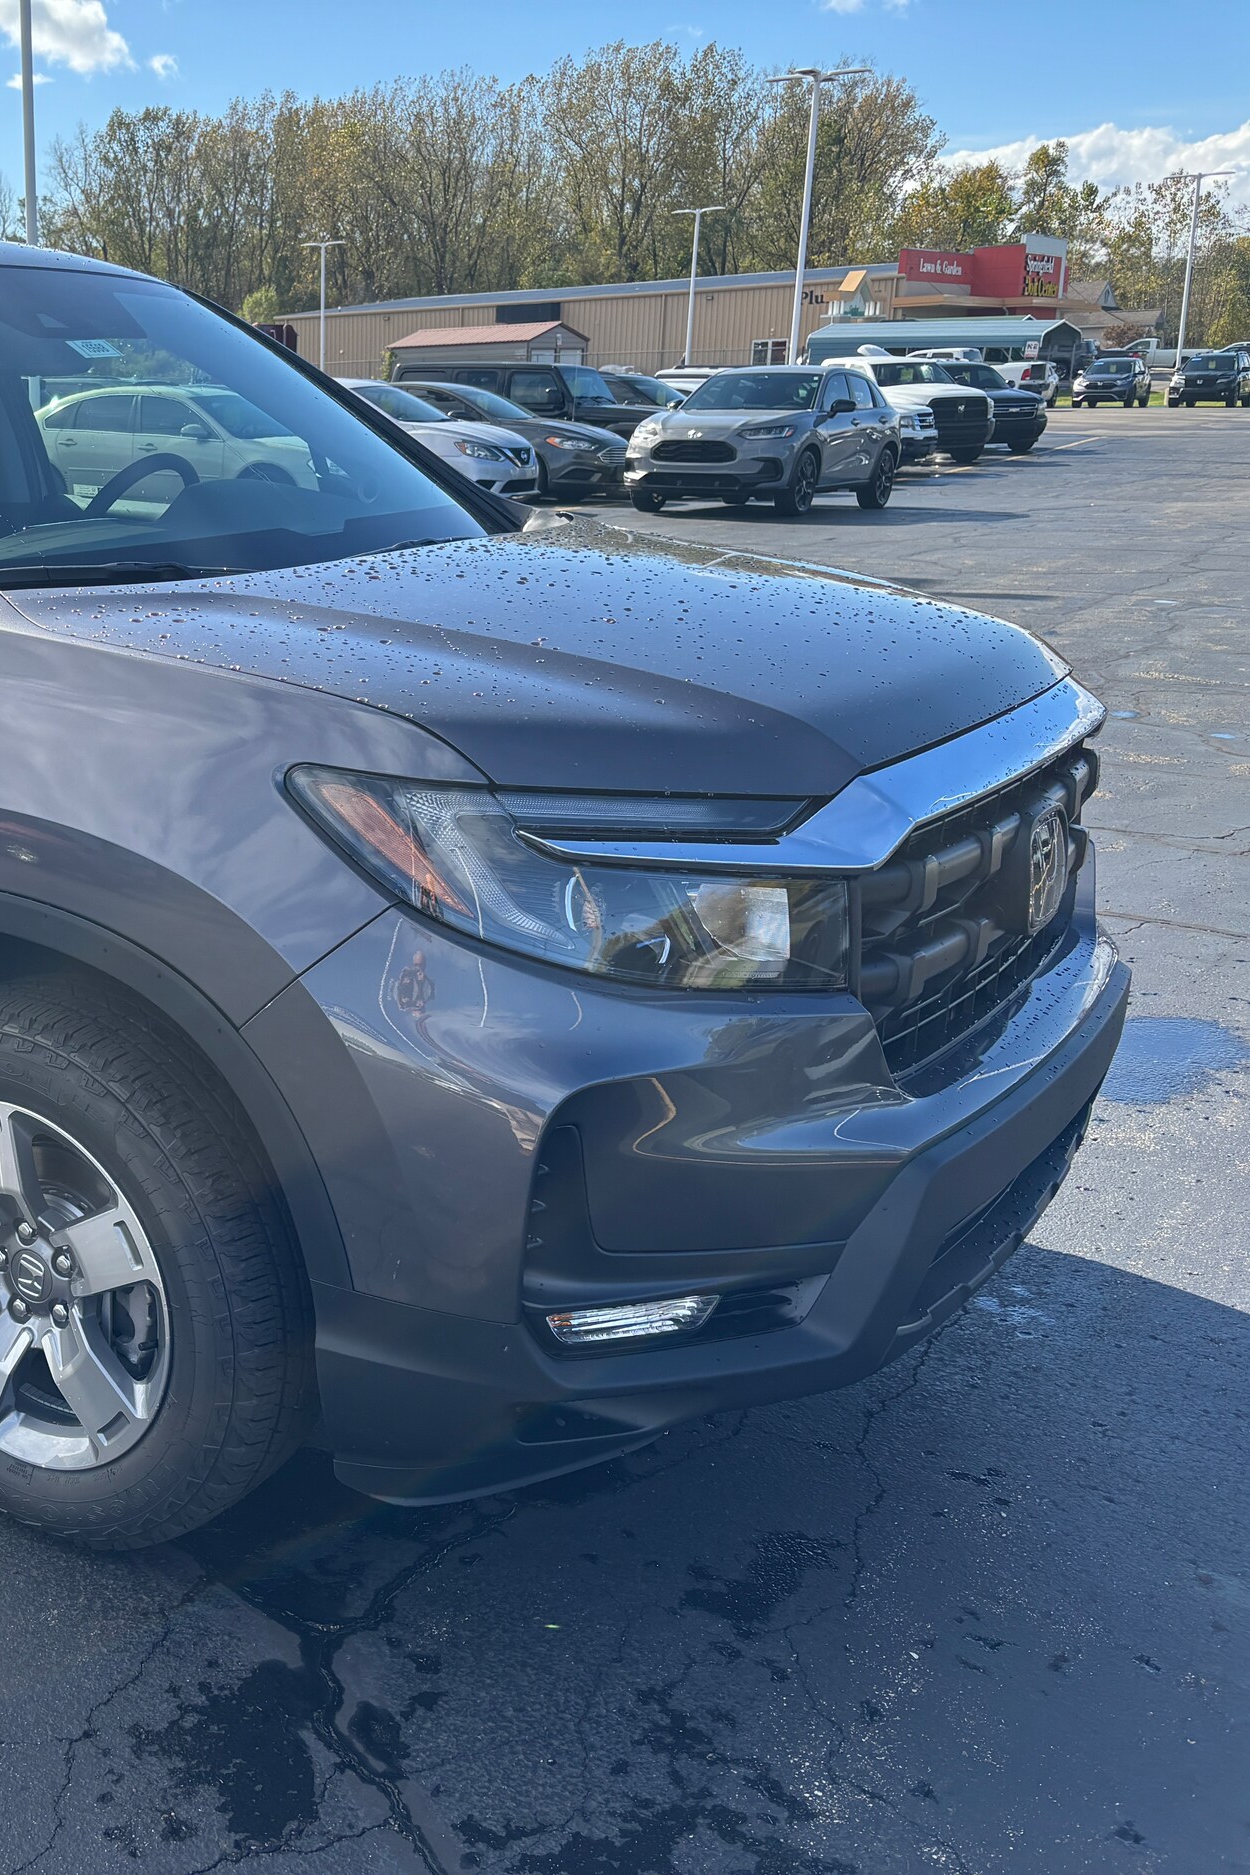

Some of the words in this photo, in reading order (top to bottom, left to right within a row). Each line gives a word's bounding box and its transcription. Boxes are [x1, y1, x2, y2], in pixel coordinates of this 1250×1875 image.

[919, 257, 935, 273] Lawn
[935, 259, 942, 275] &
[942, 260, 962, 276] Garden
